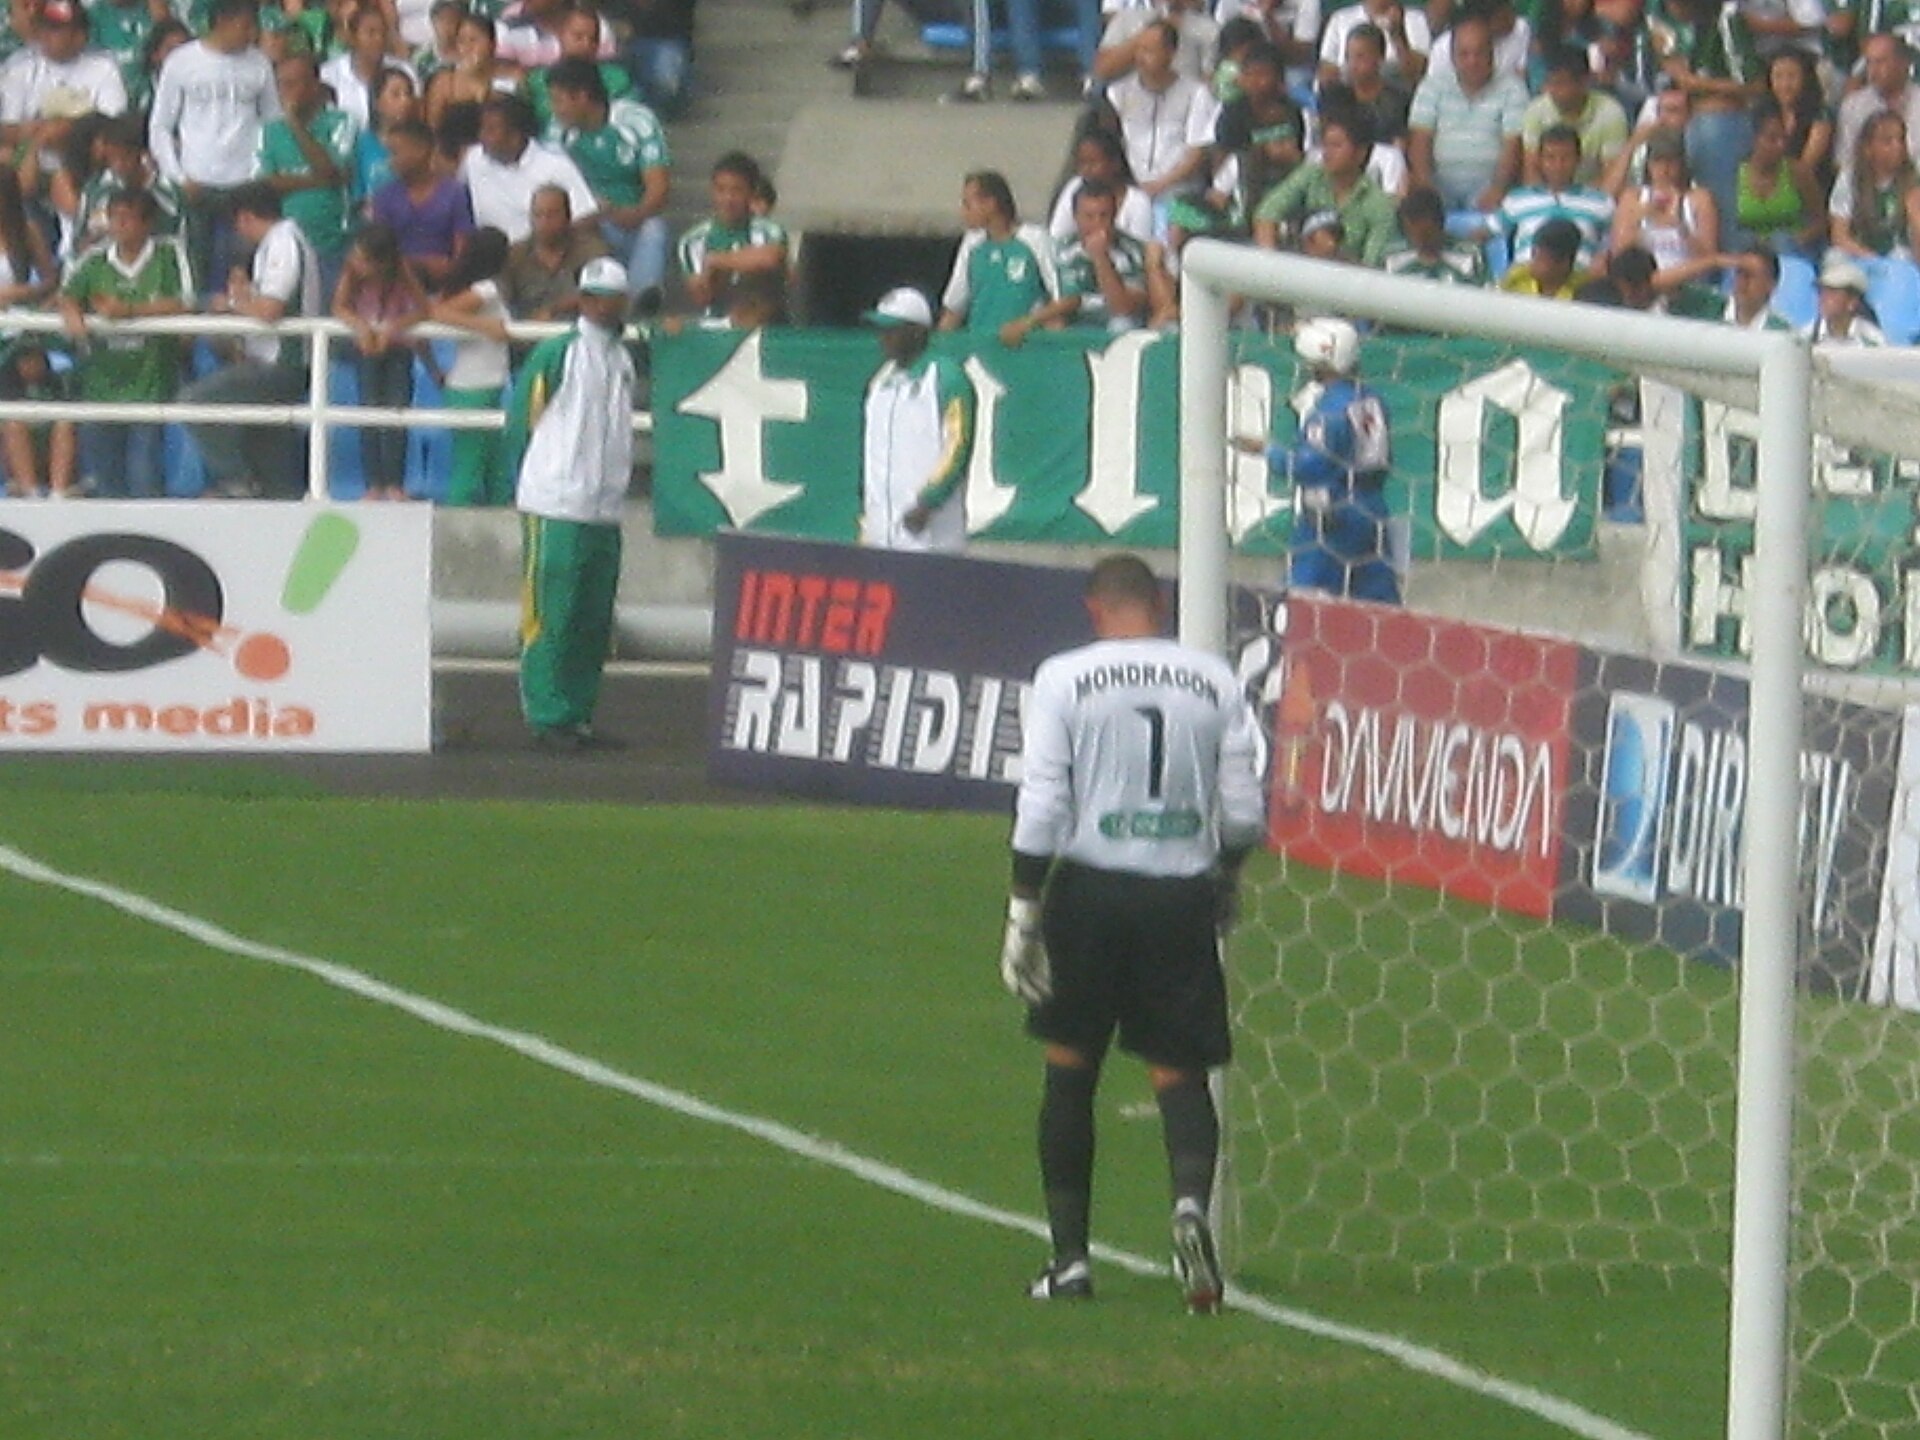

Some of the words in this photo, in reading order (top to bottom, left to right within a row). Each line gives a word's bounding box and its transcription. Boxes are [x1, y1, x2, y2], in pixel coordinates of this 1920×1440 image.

[736, 570, 896, 657] INTER
[83, 697, 316, 738] media
[1076, 664, 1220, 711] MONDRAGON
[1134, 704, 1165, 799] 1
[1320, 700, 1551, 858] DAVIVIENDA
